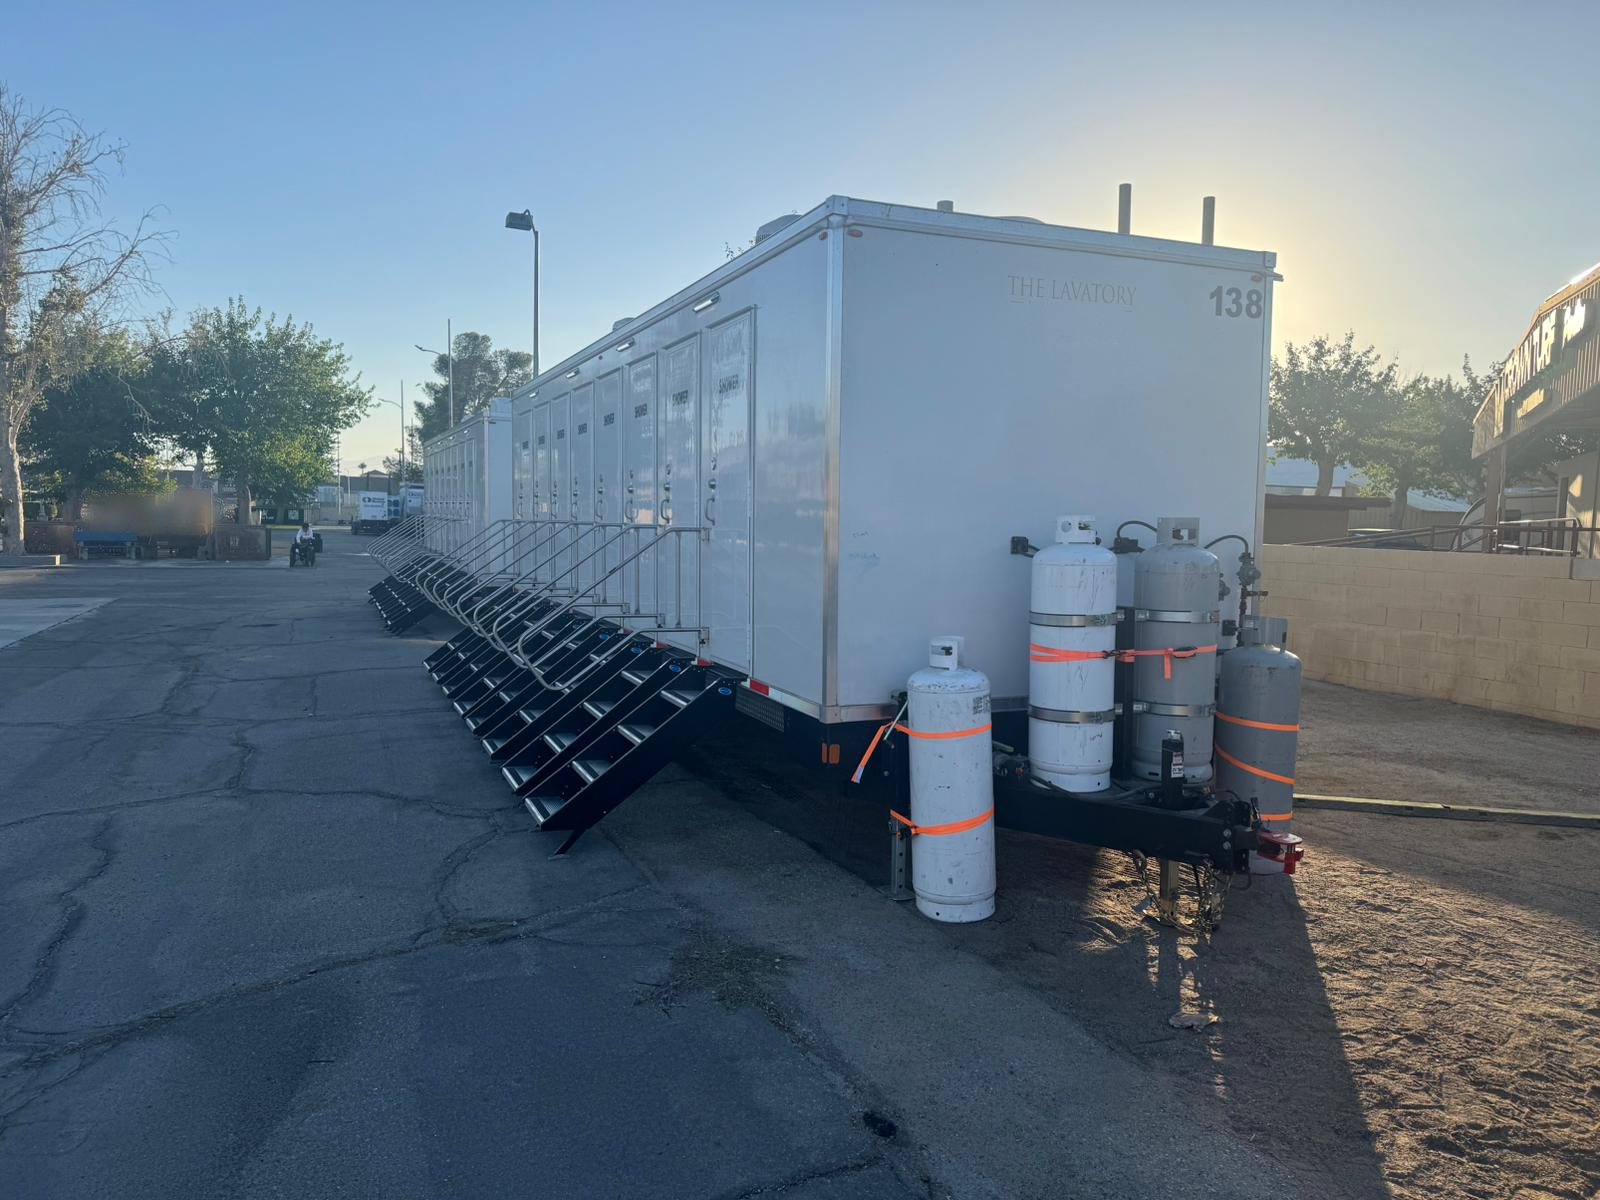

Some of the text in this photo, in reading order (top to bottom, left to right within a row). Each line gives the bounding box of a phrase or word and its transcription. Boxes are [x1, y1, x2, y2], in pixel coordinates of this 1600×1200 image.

[1007, 275, 1137, 306] THE LAVATORY
[1209, 285, 1263, 319] 138
[718, 373, 739, 394] SHOWER
